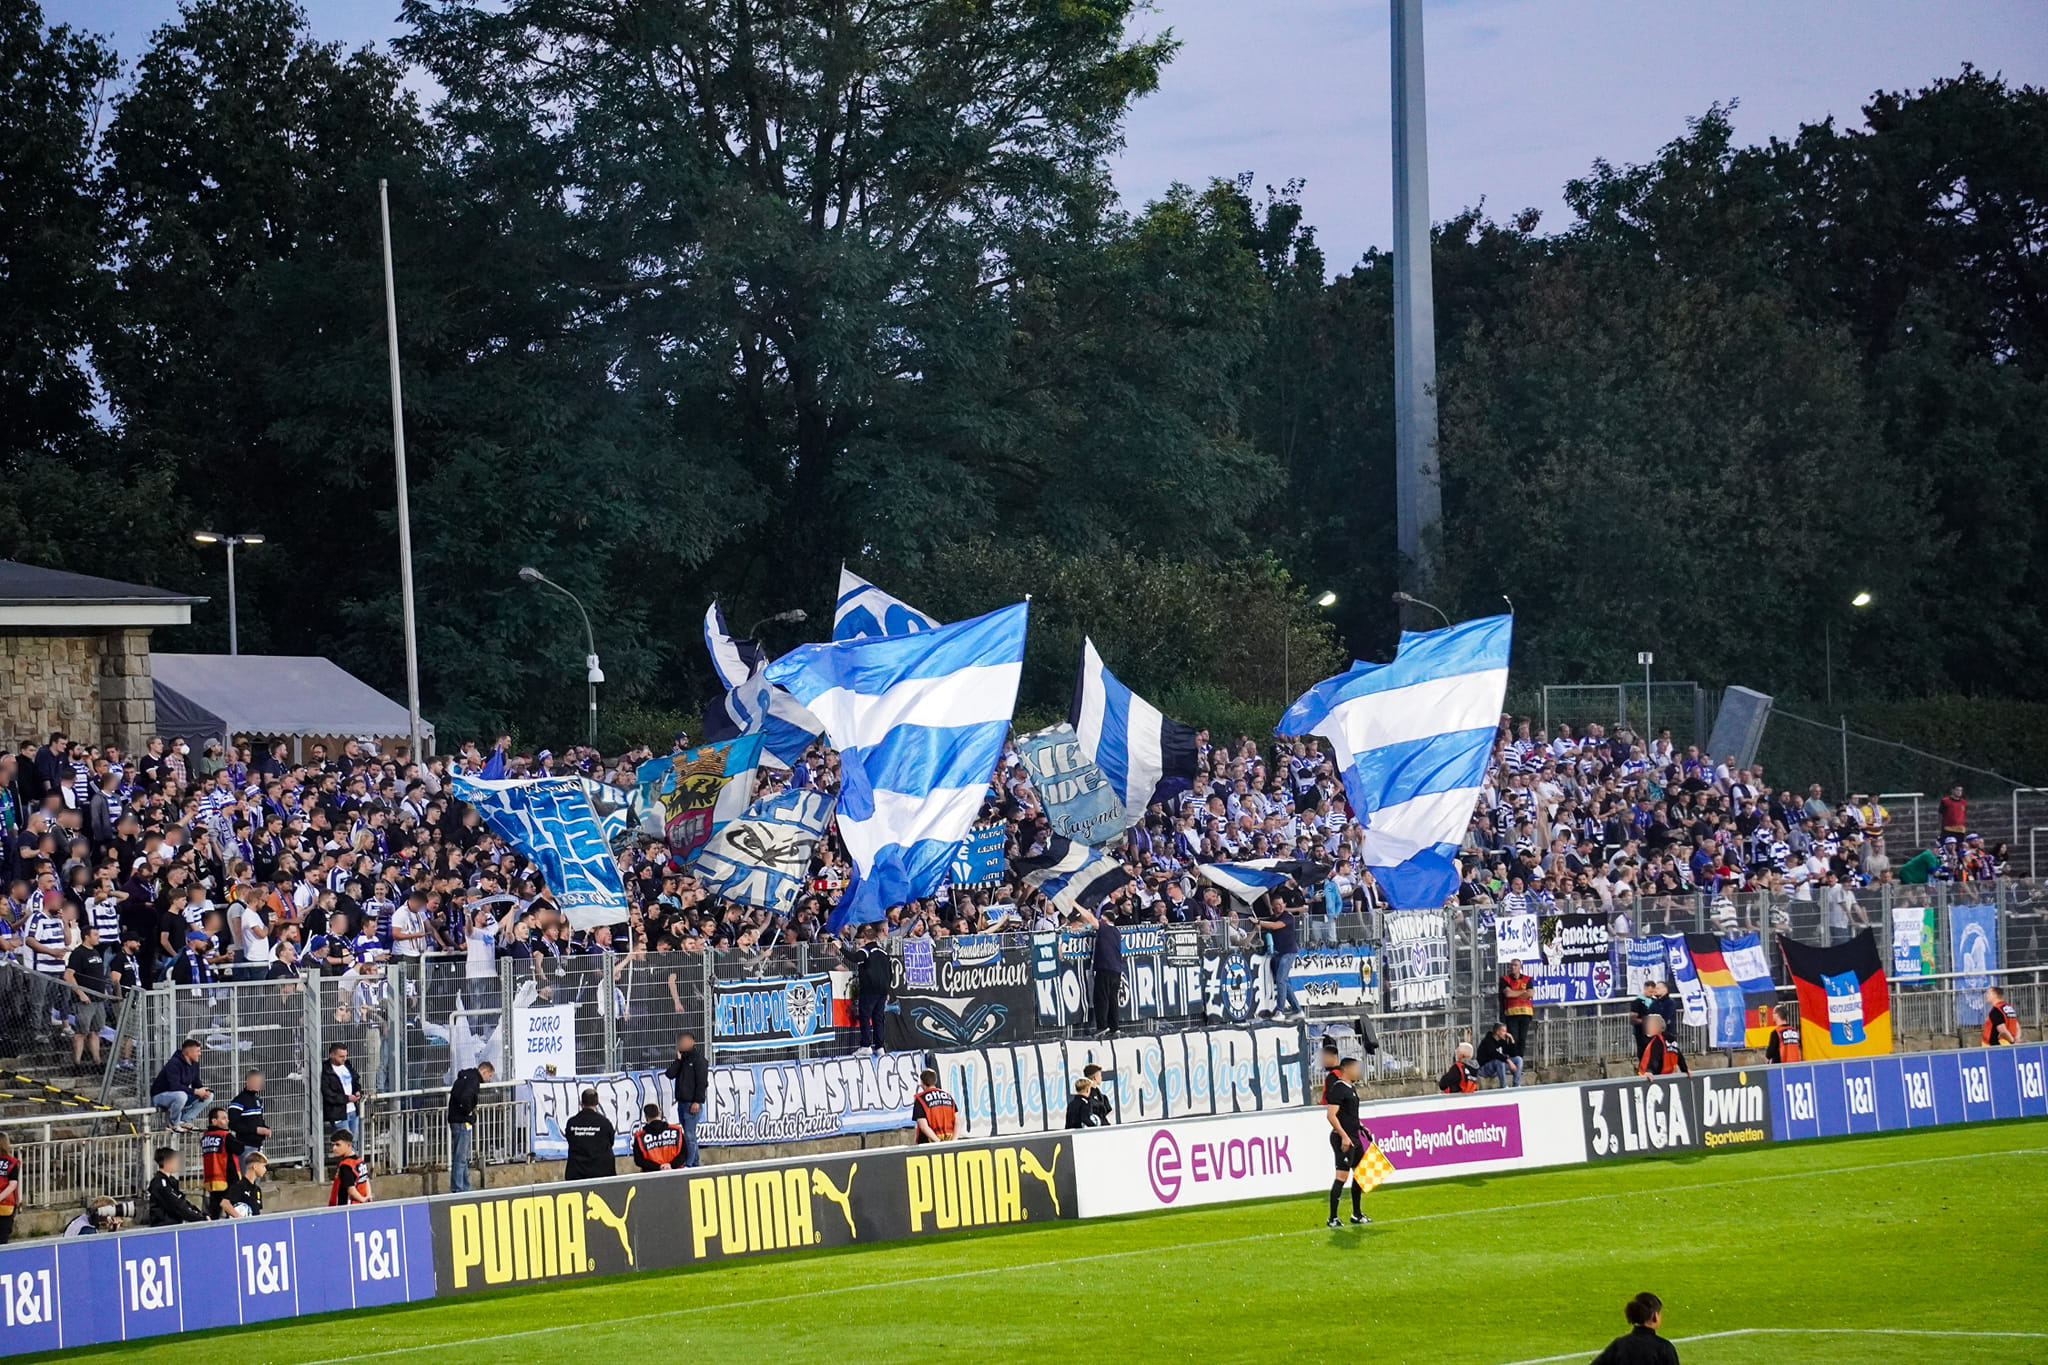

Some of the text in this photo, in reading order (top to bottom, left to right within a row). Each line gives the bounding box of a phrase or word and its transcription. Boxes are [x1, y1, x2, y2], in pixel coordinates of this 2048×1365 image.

[1058, 796, 1120, 838] Jugend
[942, 958, 1028, 997] Generation
[1521, 961, 1566, 981] upporters
[1532, 978, 1566, 1003] uisburg
[529, 1015, 561, 1033] ZORRO
[714, 982, 833, 1037] METROPOL 47
[527, 1036, 563, 1054] ZEBRAS
[706, 1066, 755, 1122] IST
[1703, 1071, 1764, 1128] bwin
[1846, 1077, 1874, 1115] 1&1
[1904, 1072, 1933, 1109] 1&1
[1962, 1066, 1990, 1104] 1&1
[2018, 1062, 2044, 1099] 1&1
[1588, 1083, 1691, 1156] 3. LIGA
[1786, 1082, 1815, 1121] 1&1
[757, 1109, 842, 1141] Anstoßzeiten
[1413, 1124, 1453, 1155] Beyond
[1454, 1122, 1508, 1148] Chemistry
[1704, 1127, 1765, 1149] Sportwetten
[1191, 1135, 1293, 1182] EVONIK
[905, 1147, 1022, 1233] PUMA
[688, 1167, 815, 1259] PUMA
[353, 1228, 401, 1281] 1&1
[450, 1191, 588, 1289] PUMA
[125, 1255, 174, 1312] 1&1
[241, 1241, 290, 1296] 1&1
[1, 1269, 52, 1327] 1&1
